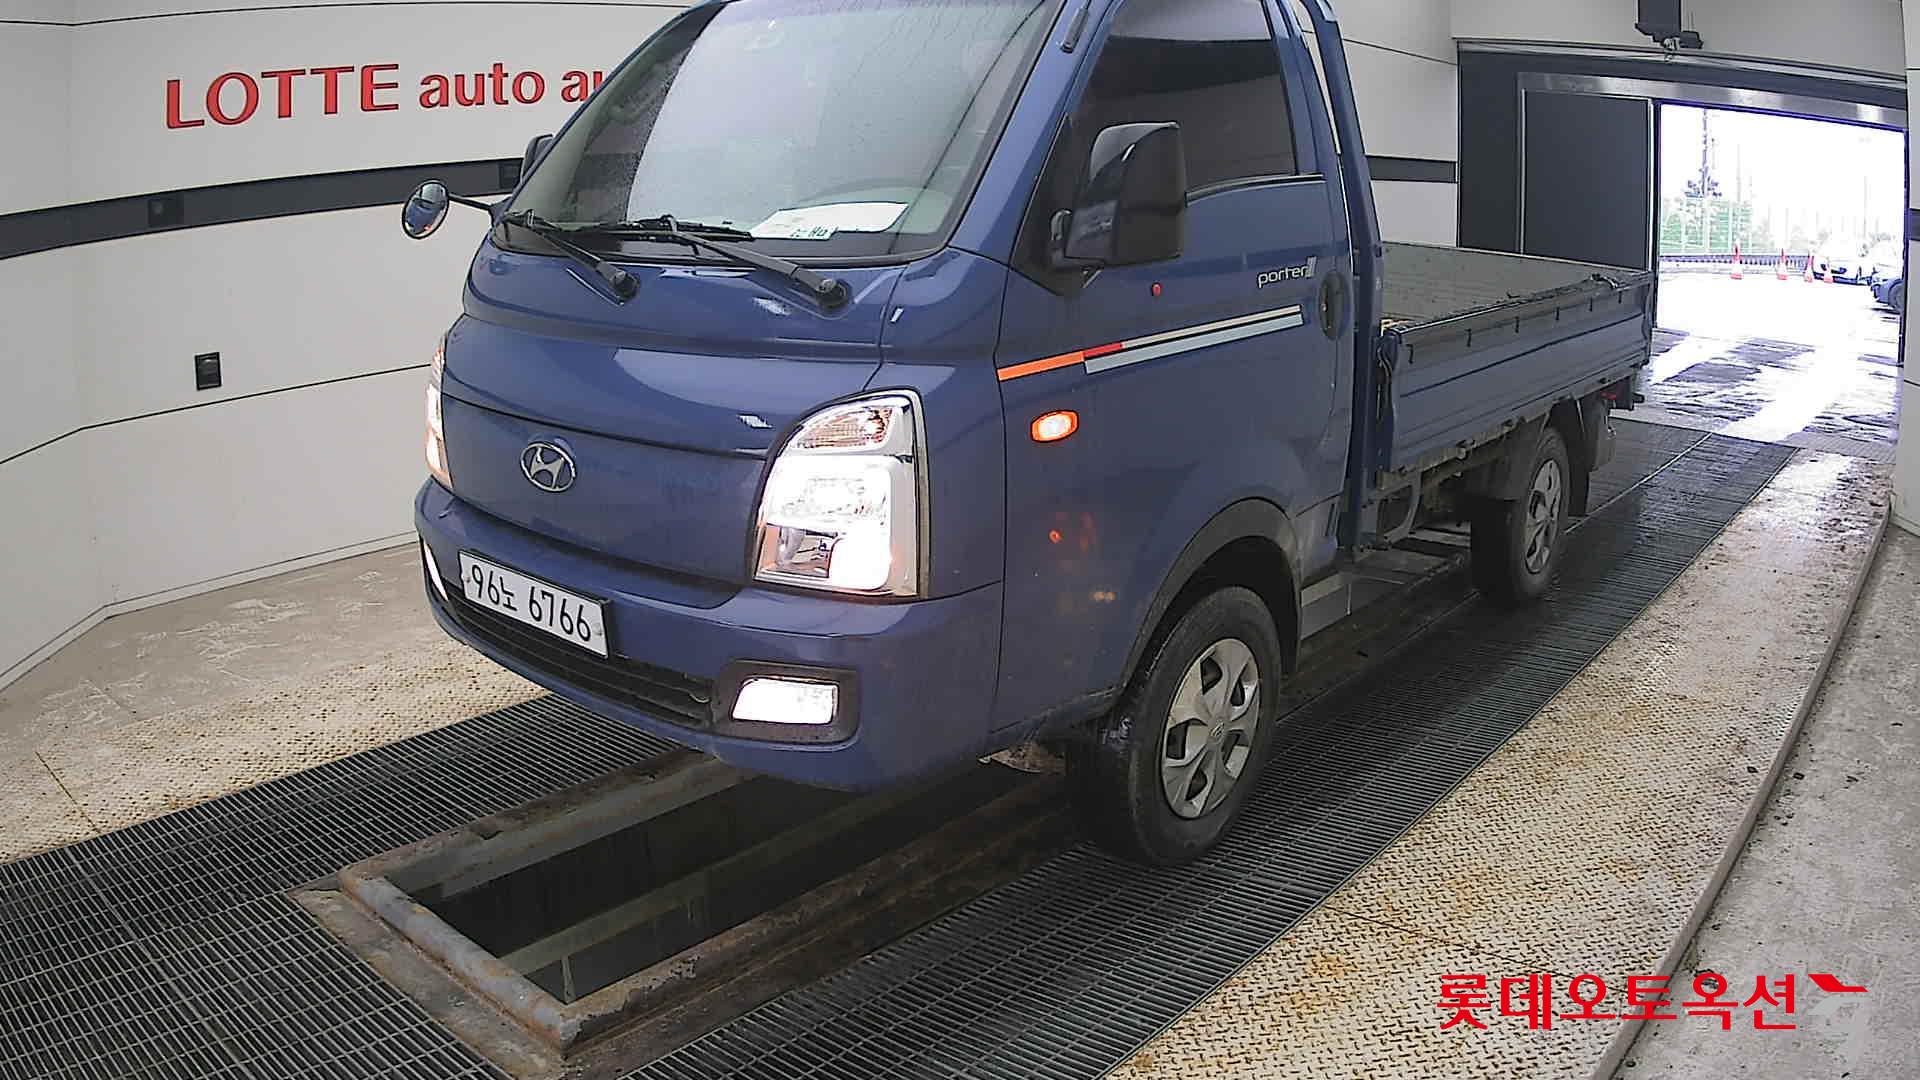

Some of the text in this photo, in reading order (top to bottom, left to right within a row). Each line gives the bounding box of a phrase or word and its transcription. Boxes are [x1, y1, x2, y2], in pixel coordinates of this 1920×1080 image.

[166, 63, 399, 129] LOTTE
[419, 62, 546, 109] auto
[471, 564, 592, 642] 96노 6766
